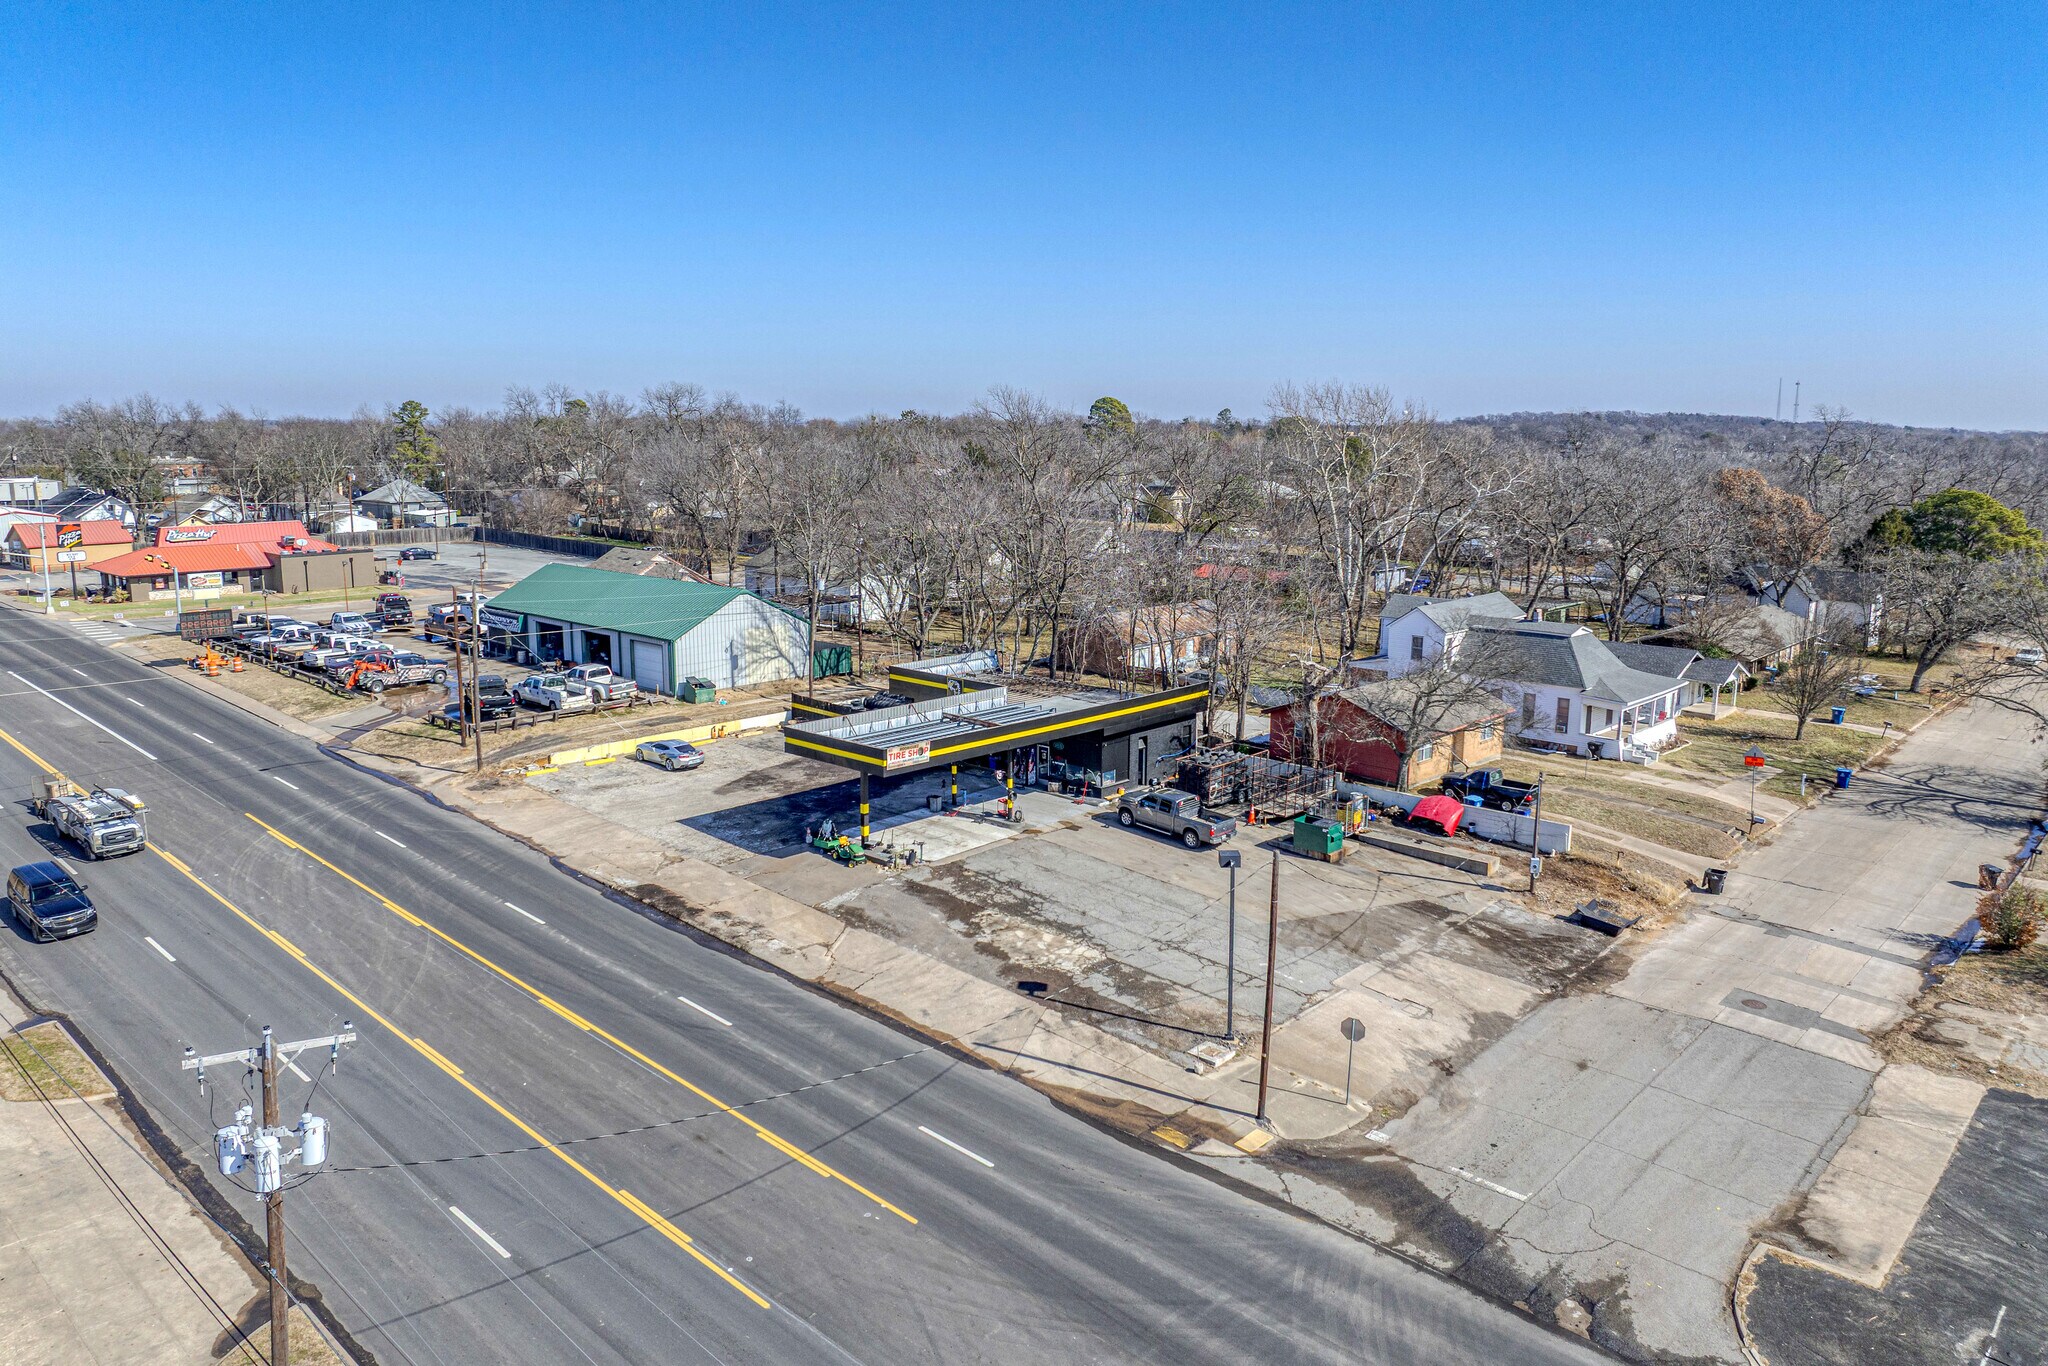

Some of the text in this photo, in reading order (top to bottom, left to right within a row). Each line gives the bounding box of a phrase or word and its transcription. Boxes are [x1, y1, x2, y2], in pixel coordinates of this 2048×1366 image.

[59, 530, 81, 545] Pizza
[63, 534, 81, 547] Hut
[166, 528, 218, 541] Pizza Hut
[181, 618, 231, 629] PREPARED
[888, 751, 906, 761] TIRE
[907, 746, 929, 757] SHOP
